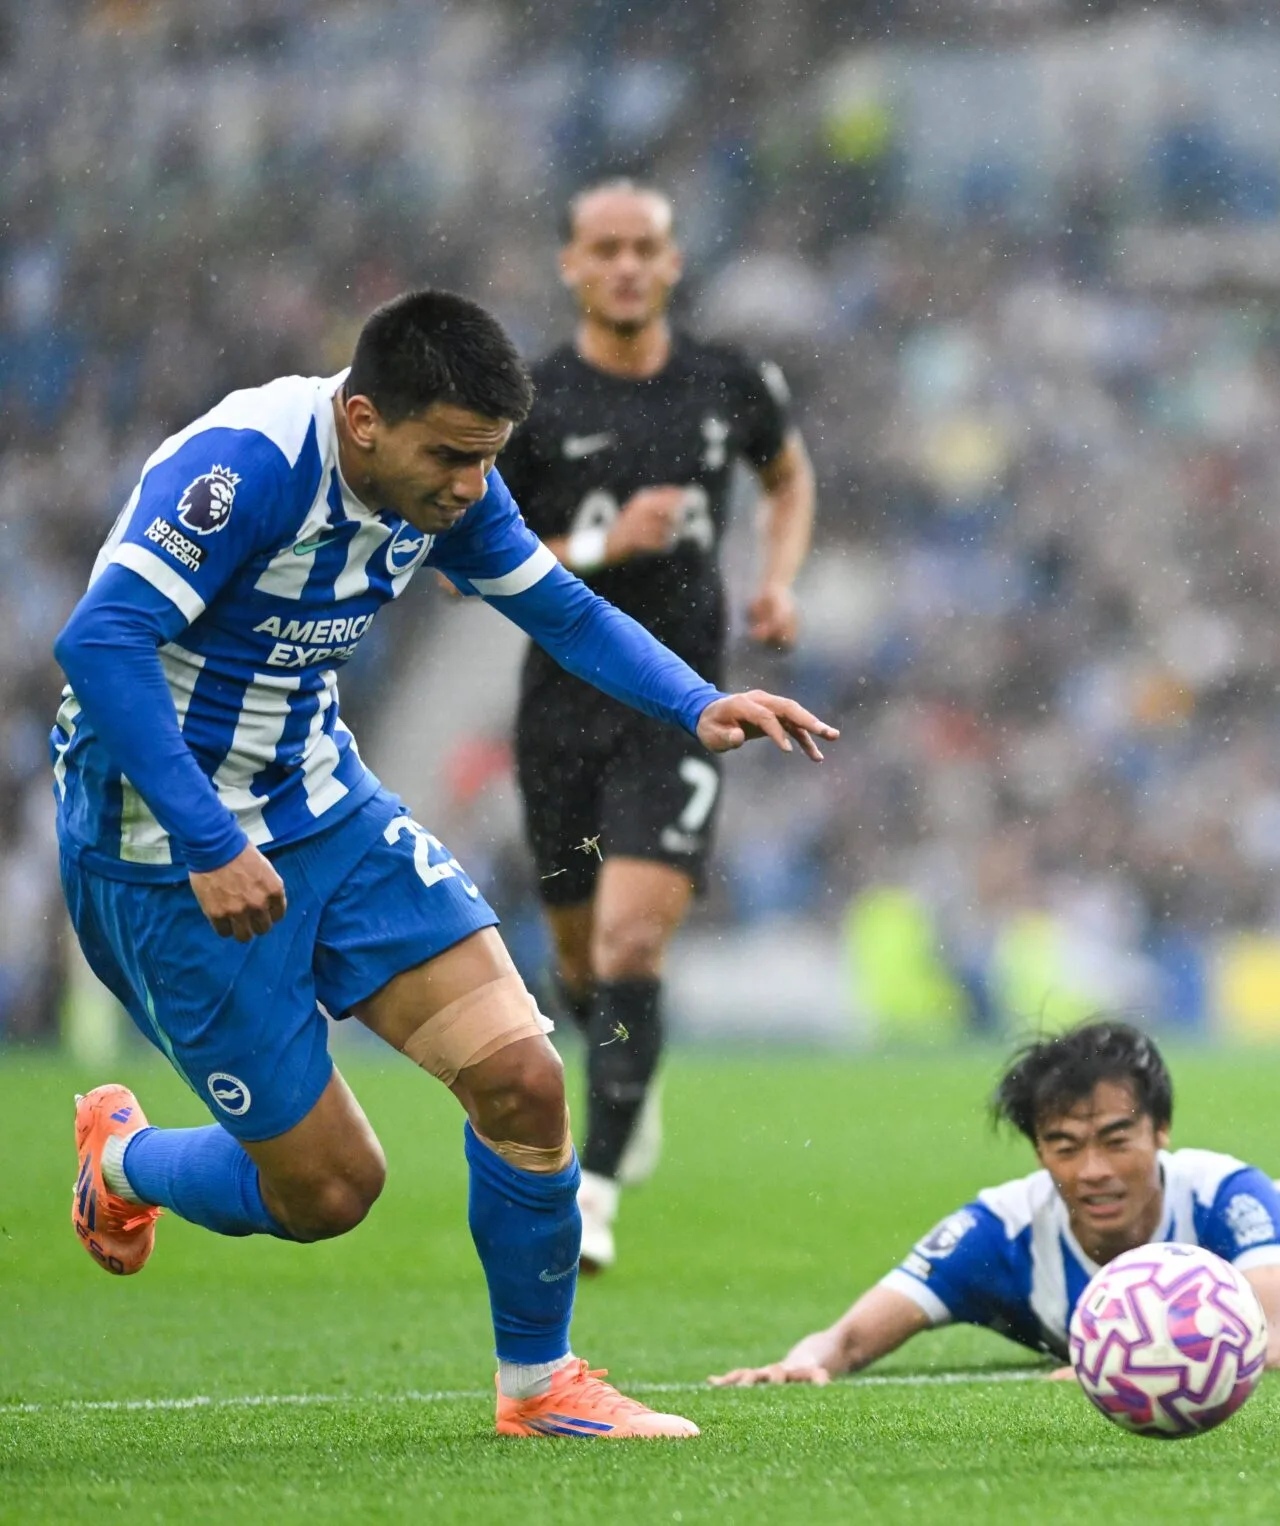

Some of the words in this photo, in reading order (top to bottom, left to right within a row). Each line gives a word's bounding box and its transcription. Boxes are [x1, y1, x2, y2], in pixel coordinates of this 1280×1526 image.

[161, 537, 200, 572] racism
[168, 529, 202, 560] room
[679, 756, 719, 831] 7
